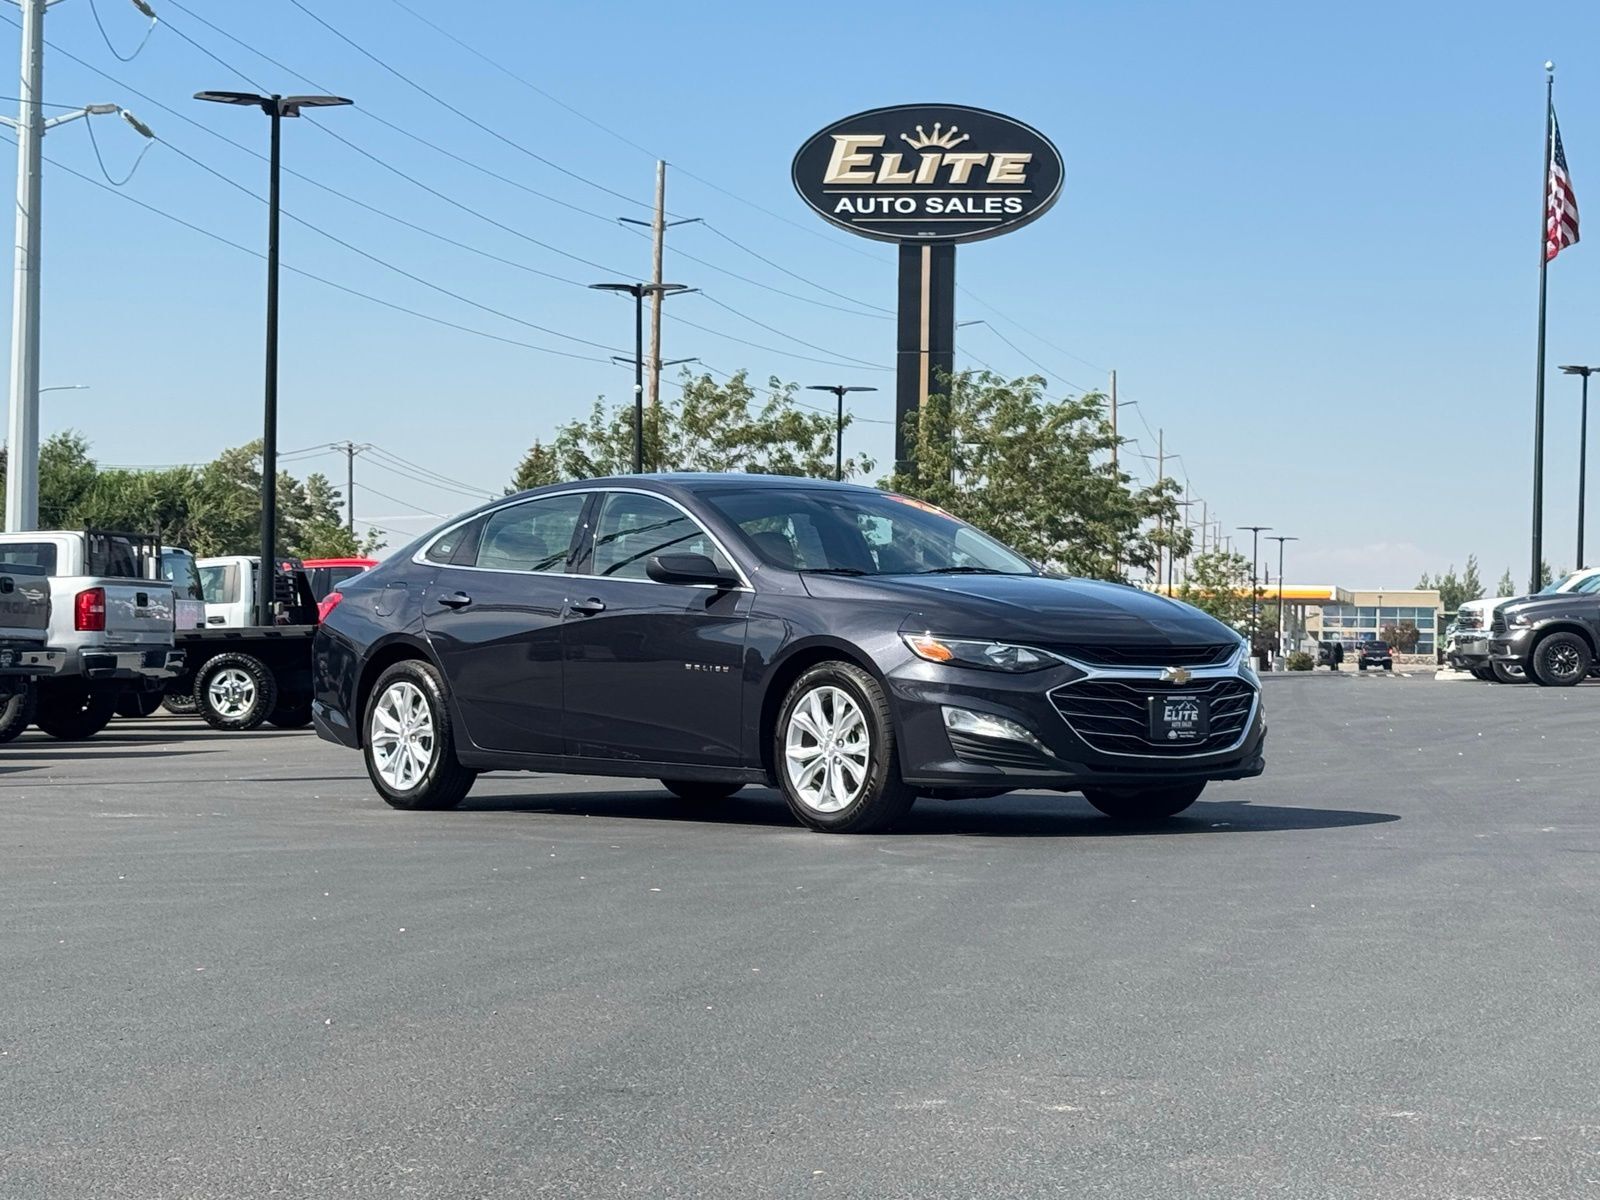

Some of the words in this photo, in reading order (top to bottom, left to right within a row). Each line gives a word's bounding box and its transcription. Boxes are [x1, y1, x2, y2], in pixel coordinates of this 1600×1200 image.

[822, 134, 1033, 185] ELITE
[834, 197, 917, 214] AUTO
[924, 197, 1023, 214] SALES
[1164, 706, 1199, 721] ELITE
